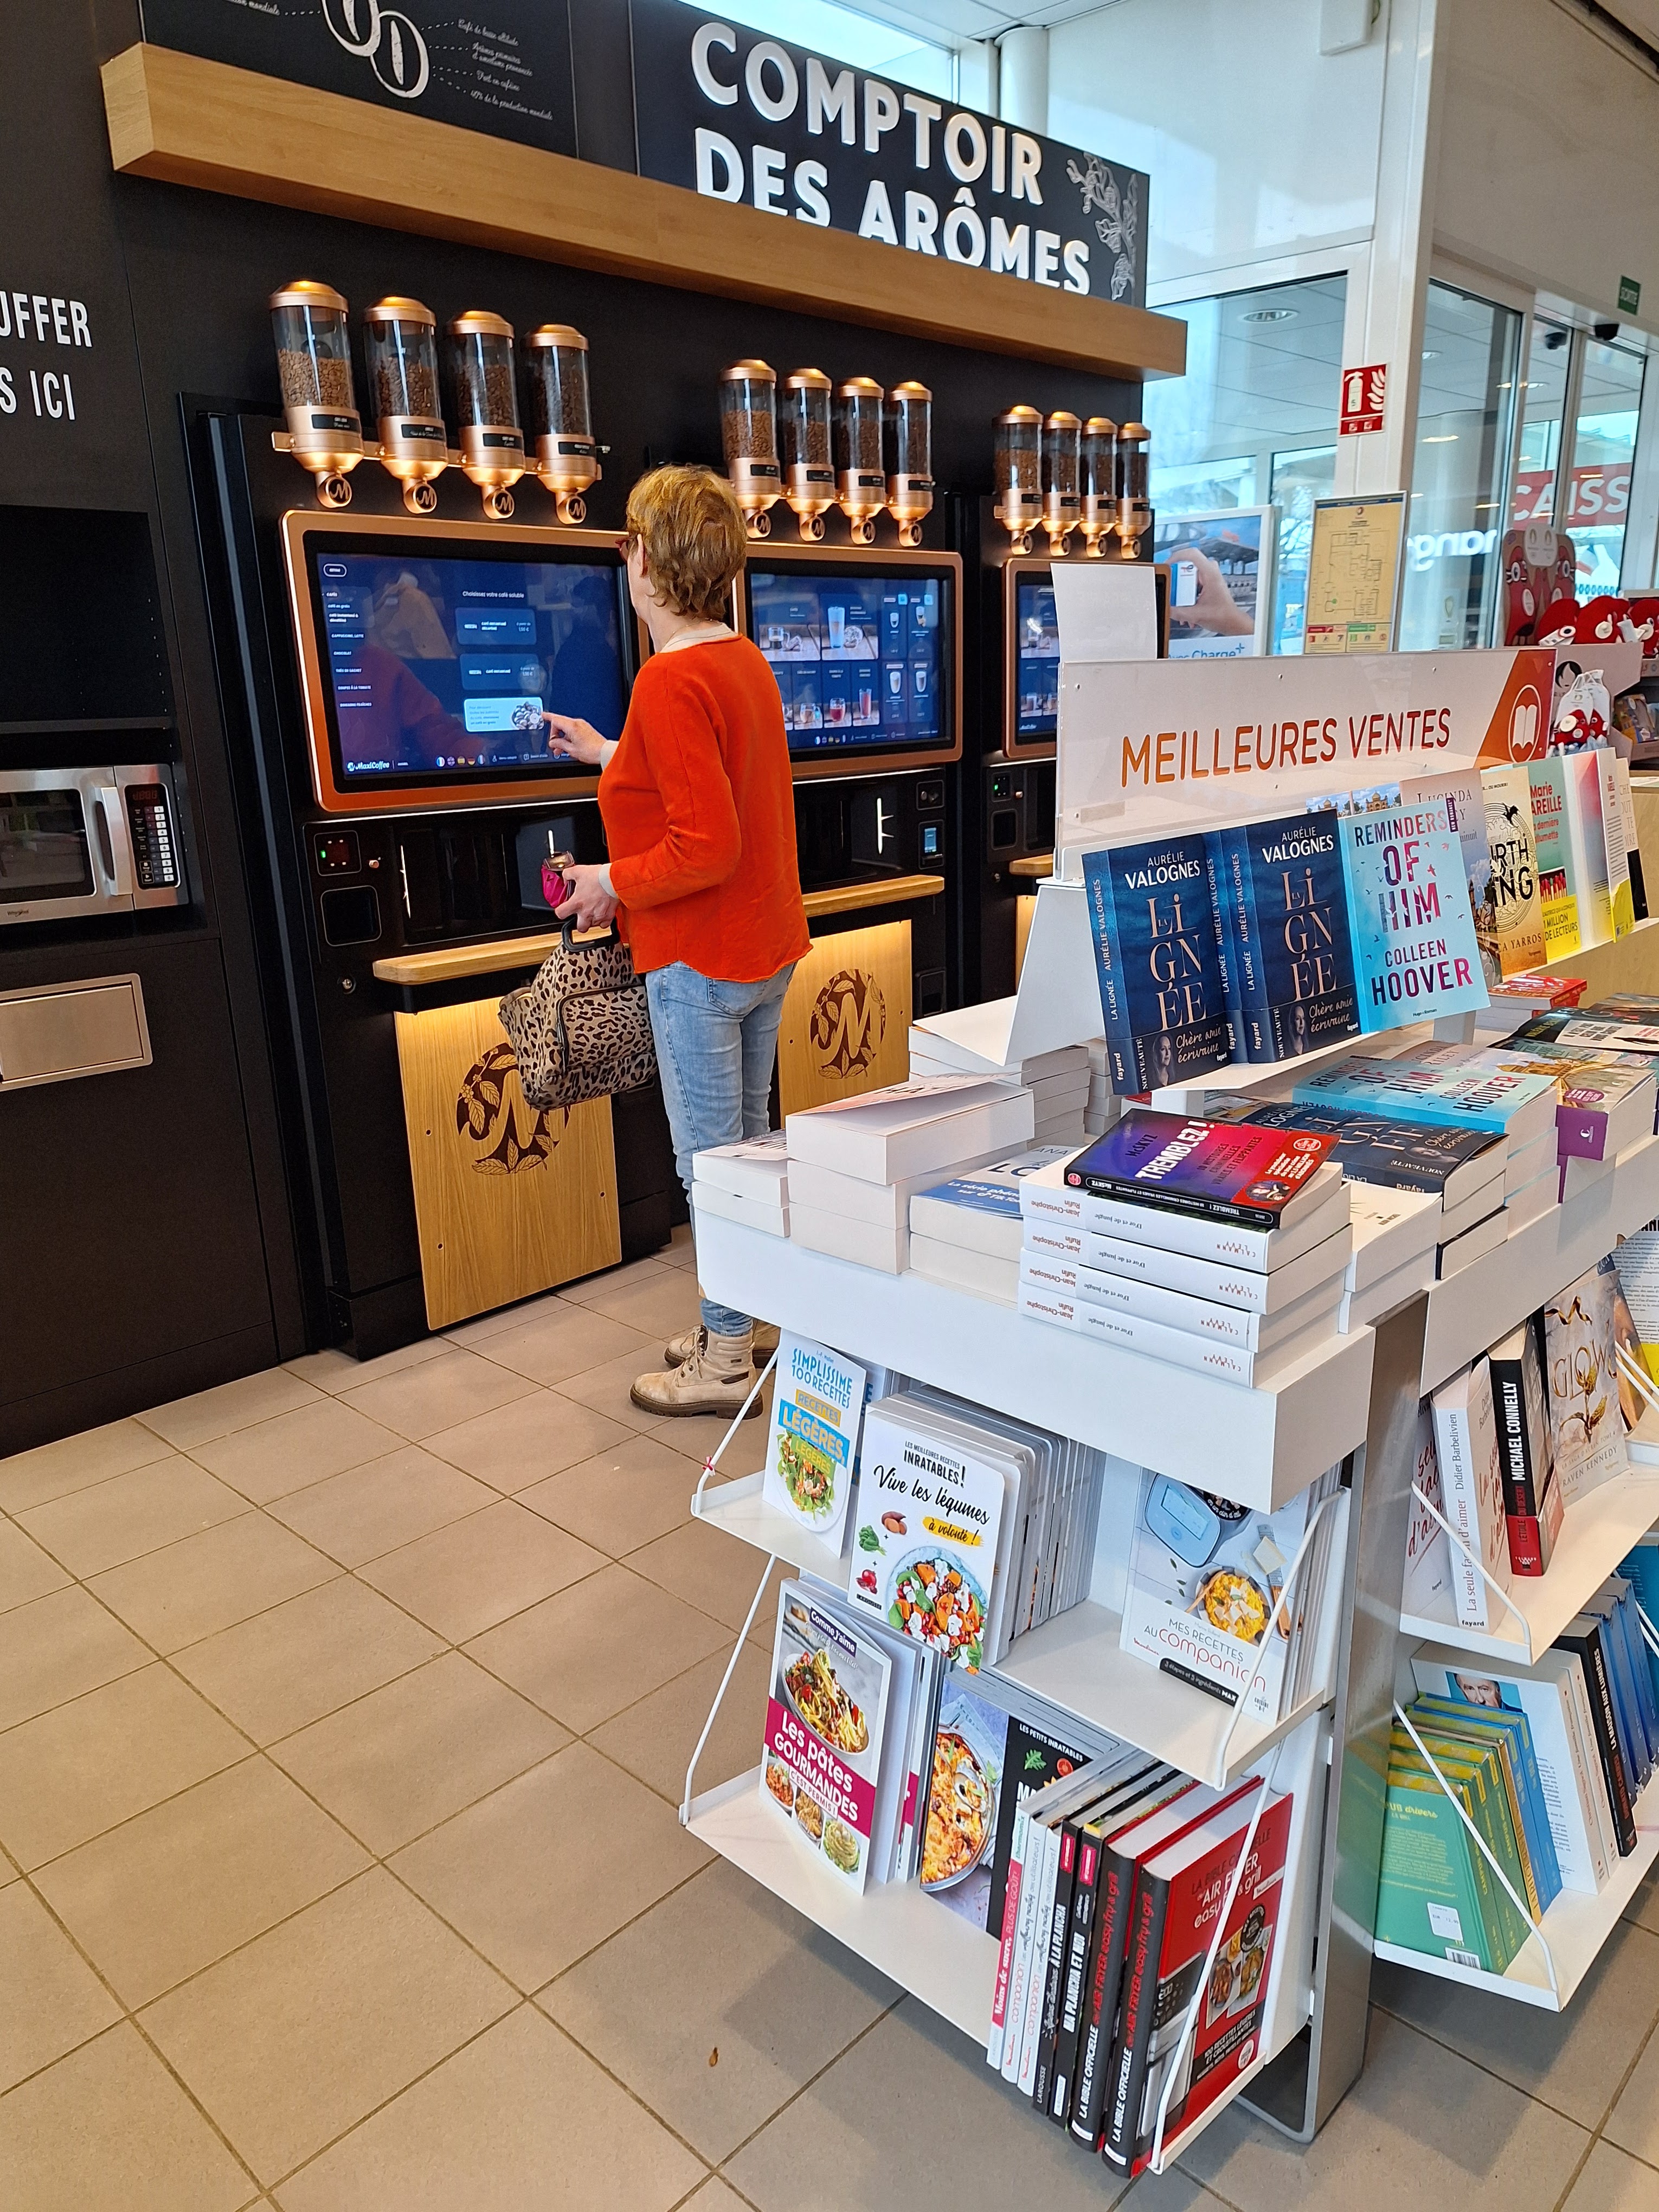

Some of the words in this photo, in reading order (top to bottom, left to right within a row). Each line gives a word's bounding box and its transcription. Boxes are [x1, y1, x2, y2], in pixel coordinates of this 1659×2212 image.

[692, 22, 1044, 205] COMPTOIR
[695, 127, 831, 227] DES
[858, 187, 1090, 295] ARÔMES
[30, 370, 75, 420] ICI
[1121, 718, 1337, 788] MEILLEURES
[1348, 708, 1451, 758] VENTES
[1530, 781, 1553, 799] Marie
[1281, 826, 1317, 843] AURÉLIE
[1354, 809, 1448, 847] REMINDERS
[1147, 851, 1185, 867] AURÉLIE
[1262, 834, 1334, 864] VALOGNES
[1382, 840, 1419, 886] OF
[1125, 860, 1200, 890] VALOGNES
[1206, 858, 1219, 906] VALOGNES
[1231, 853, 1244, 904] VALOGNES
[1093, 879, 1105, 931] VALOGNES
[1378, 882, 1442, 933] HIM
[1547, 913, 1568, 927] MILLION
[1213, 907, 1223, 946] AURÉLIE
[1238, 904, 1248, 943] AURÉLIE
[1284, 907, 1333, 955] GN
[1510, 933, 1542, 949] YARROS
[1545, 931, 1553, 941] DE
[1554, 922, 1578, 938] LECTEURS
[1100, 930, 1111, 971] AURÉLIE
[1150, 934, 1203, 983] GN
[1219, 954, 1227, 980] LIGNÉE
[1384, 938, 1447, 967] COLLEEN
[1108, 979, 1117, 1008] LIGNÉE
[1290, 953, 1338, 1002] ÉE
[1371, 957, 1474, 1006] HOOVER
[1156, 981, 1207, 1032] ÉE
[1228, 1023, 1236, 1050] fayard
[1252, 1022, 1260, 1050] fayard
[1273, 1008, 1285, 1059] NOUVEAUTÉ
[1116, 1053, 1124, 1081] fayard
[1136, 1038, 1148, 1091] NOUVEAUTÉ
[1439, 1078, 1483, 1100] COLLEEN
[1453, 1075, 1527, 1112] HOOVER
[961, 1183, 988, 1191] série
[1064, 1199, 1081, 1208] Rufin
[1031, 1200, 1080, 1217] Jean-Christophe
[1094, 1213, 1113, 1223] jungle
[1128, 1220, 1142, 1229] D'or
[1032, 1236, 1081, 1253] Jean-Christophe
[1065, 1235, 1081, 1244] Rufin
[1098, 1251, 1117, 1261] jungle
[1131, 1259, 1146, 1268] D'or
[792, 1348, 852, 1392] SIMPLISSIME
[792, 1365, 811, 1385] 100
[812, 1372, 850, 1409] RECETTES
[1502, 1381, 1521, 1435] CONNELLY
[1450, 1413, 1461, 1461] Barbelivien
[903, 1449, 959, 1485] INRATABLES
[915, 1443, 939, 1461] MEILLEURES
[940, 1454, 960, 1469] RECETTES
[1510, 1436, 1526, 1481] MICHAEL
[1562, 1469, 1584, 1487] RAVEN
[1586, 1445, 1618, 1472] KENNEDY
[1454, 1463, 1464, 1490] Didier
[873, 1465, 908, 1493] Vive
[911, 1478, 932, 1501] les
[935, 1487, 991, 1525] légumes
[928, 1519, 935, 1531] à
[938, 1525, 969, 1543] volonté
[972, 1530, 978, 1545] !
[1457, 1499, 1469, 1540] d'aimer
[1465, 1570, 1474, 1593] seule
[1467, 1595, 1477, 1612] La
[812, 1611, 835, 1637] Comme
[1144, 1625, 1158, 1637] AU
[1169, 1618, 1190, 1636] MES
[1192, 1629, 1244, 1662] RECETTES
[1462, 1619, 1485, 1628] fayard
[1594, 1648, 1606, 1699] LUMIÈRES
[1222, 1689, 1236, 1702] MAX
[1019, 1724, 1028, 1734] LES
[1030, 1728, 1047, 1746] PETITS
[1047, 1736, 1083, 1762] INRATABLES
[1604, 1713, 1615, 1740] MAISON
[782, 1710, 805, 1742] Les
[807, 1737, 853, 1791] pâtes
[1610, 1741, 1617, 1751] LA
[774, 1732, 858, 1822] GOURMANDES
[790, 1769, 808, 1787] C'EST
[809, 1784, 830, 1809] PERMIS
[1405, 1805, 1438, 1819] drivers
[1194, 1905, 1221, 1928] easy
[1245, 1865, 1262, 1896] grill
[1201, 1885, 1221, 1908] AIR
[1052, 1904, 1066, 1947] PLANCHA
[994, 1986, 1006, 2016] Moins
[1005, 1918, 1014, 1933] PLUS
[1095, 1953, 1107, 1989] FRYER
[1064, 1968, 1082, 2014] PLANCHA
[1128, 1976, 1141, 2011] FRYER
[1083, 2024, 1099, 2078] OFFICIELLE
[1036, 2066, 1046, 2104] LAROUSSE
[1079, 2078, 1091, 2105] BIBLE
[1117, 2047, 1133, 2101] OFFICIELLE
[1078, 2105, 1088, 2118] LA
[1114, 2101, 1126, 2127] BIBLE
[1112, 2128, 1122, 2142] LA
